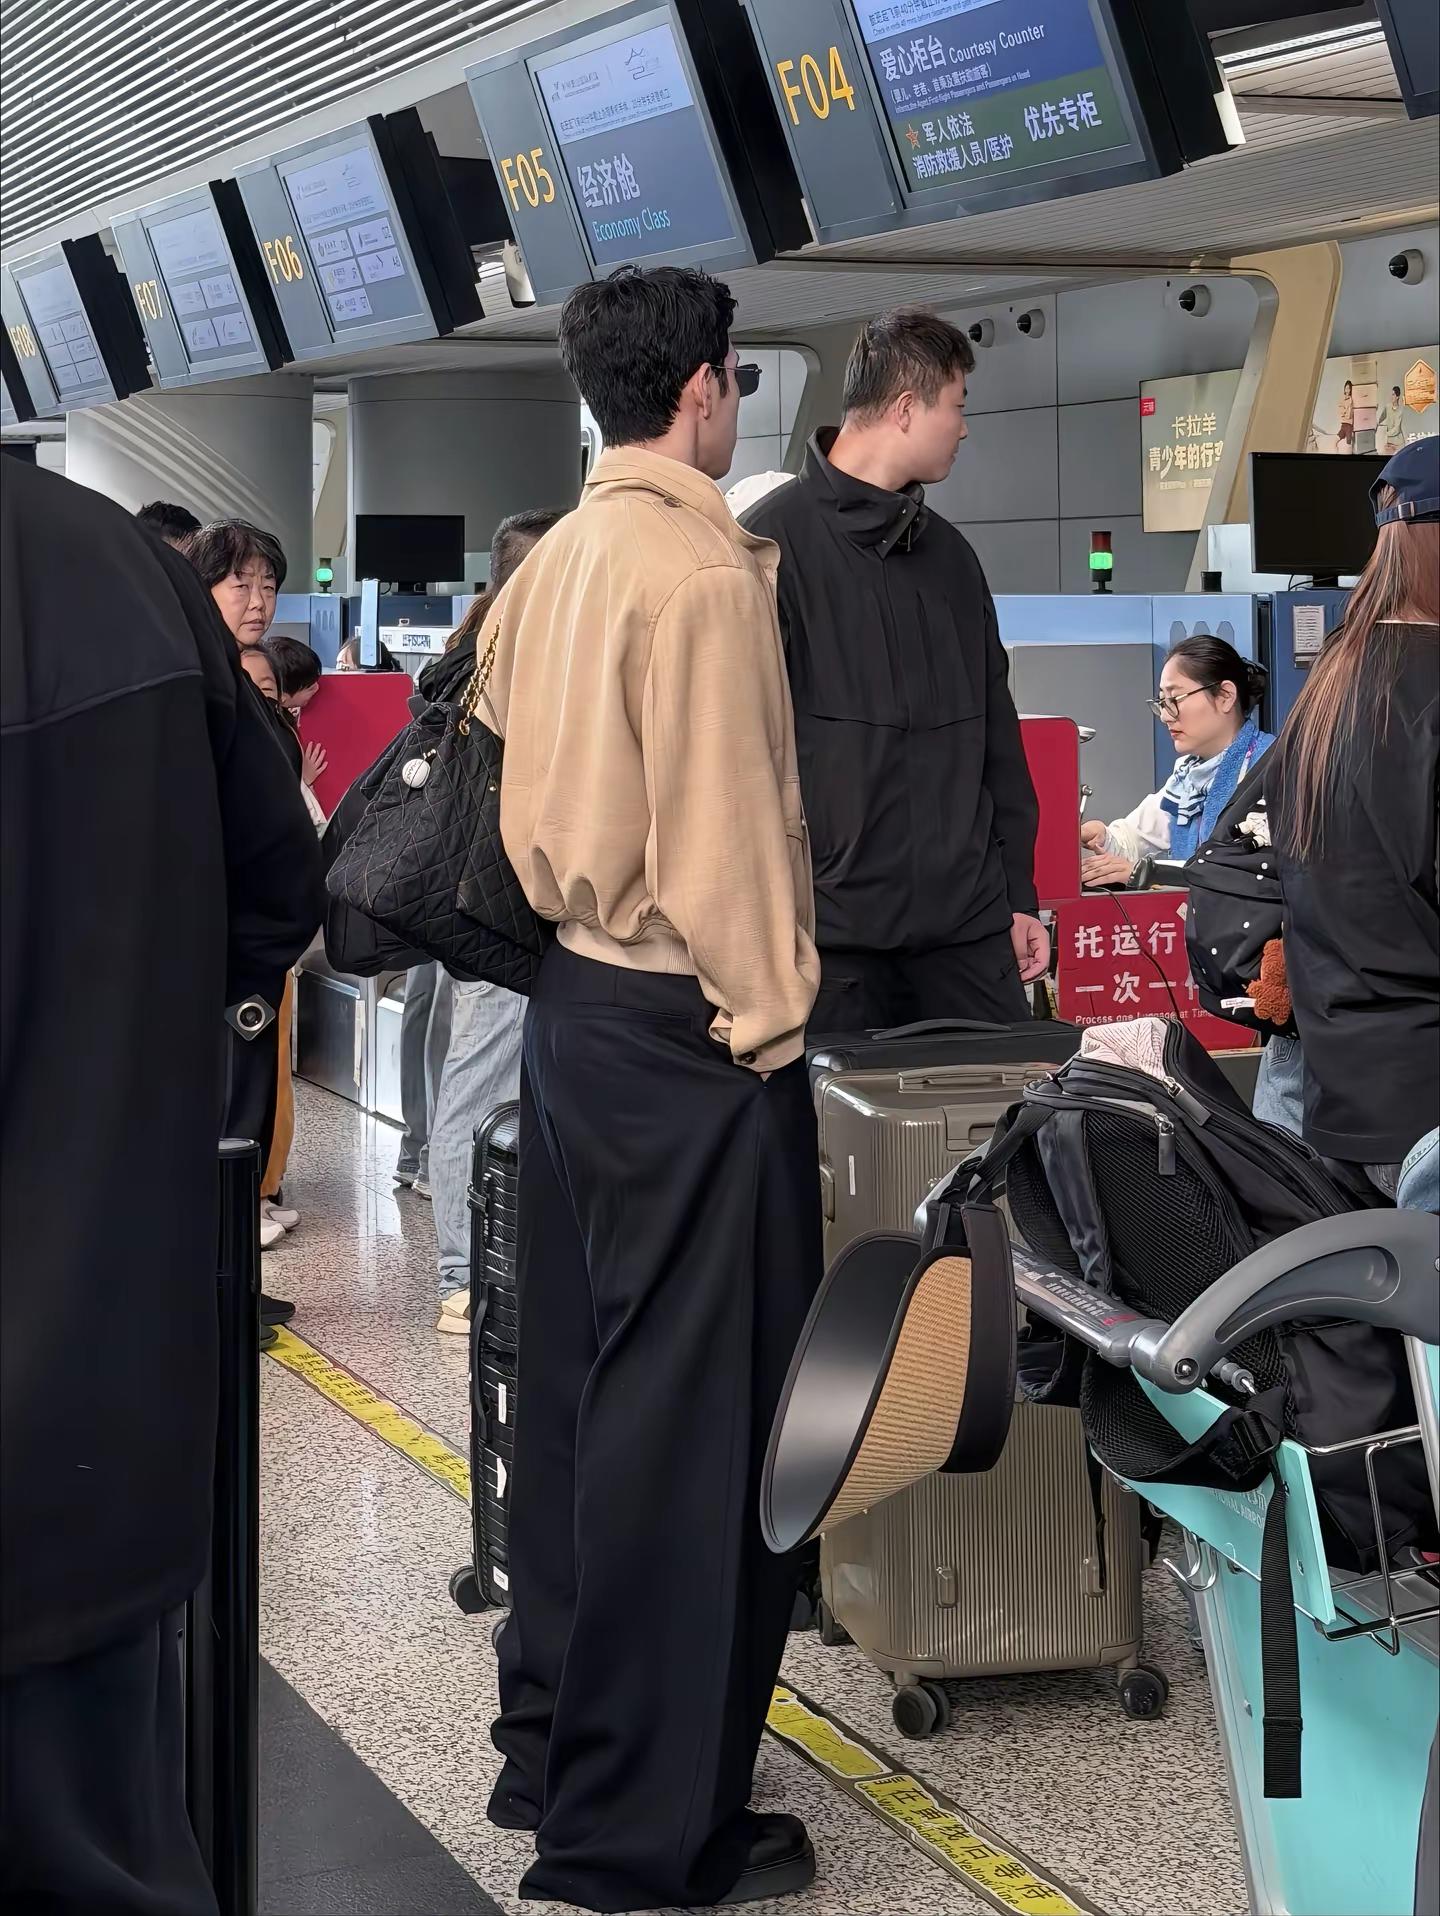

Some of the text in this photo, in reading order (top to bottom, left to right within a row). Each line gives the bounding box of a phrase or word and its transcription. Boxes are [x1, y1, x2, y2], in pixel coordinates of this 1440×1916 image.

[879, 23, 1045, 82] 爱心柜台 Courtesy Counter
[777, 46, 856, 125] F04
[922, 112, 975, 146] 军人依法
[1024, 91, 1102, 142] 优先专柜
[912, 133, 1013, 179] 消防救援人员/医护
[501, 148, 555, 212] F05
[577, 153, 641, 208] 经济舱
[592, 207, 671, 242] Economy Class
[263, 235, 304, 284] F06
[134, 280, 164, 322] F07
[9, 324, 36, 361] F08
[1171, 412, 1217, 439] 卡拉羊
[1075, 1015, 1113, 1025] Process
[1116, 1014, 1134, 1022] one
[1180, 1009, 1188, 1019] at
[957, 1858, 994, 1886] Yellow
